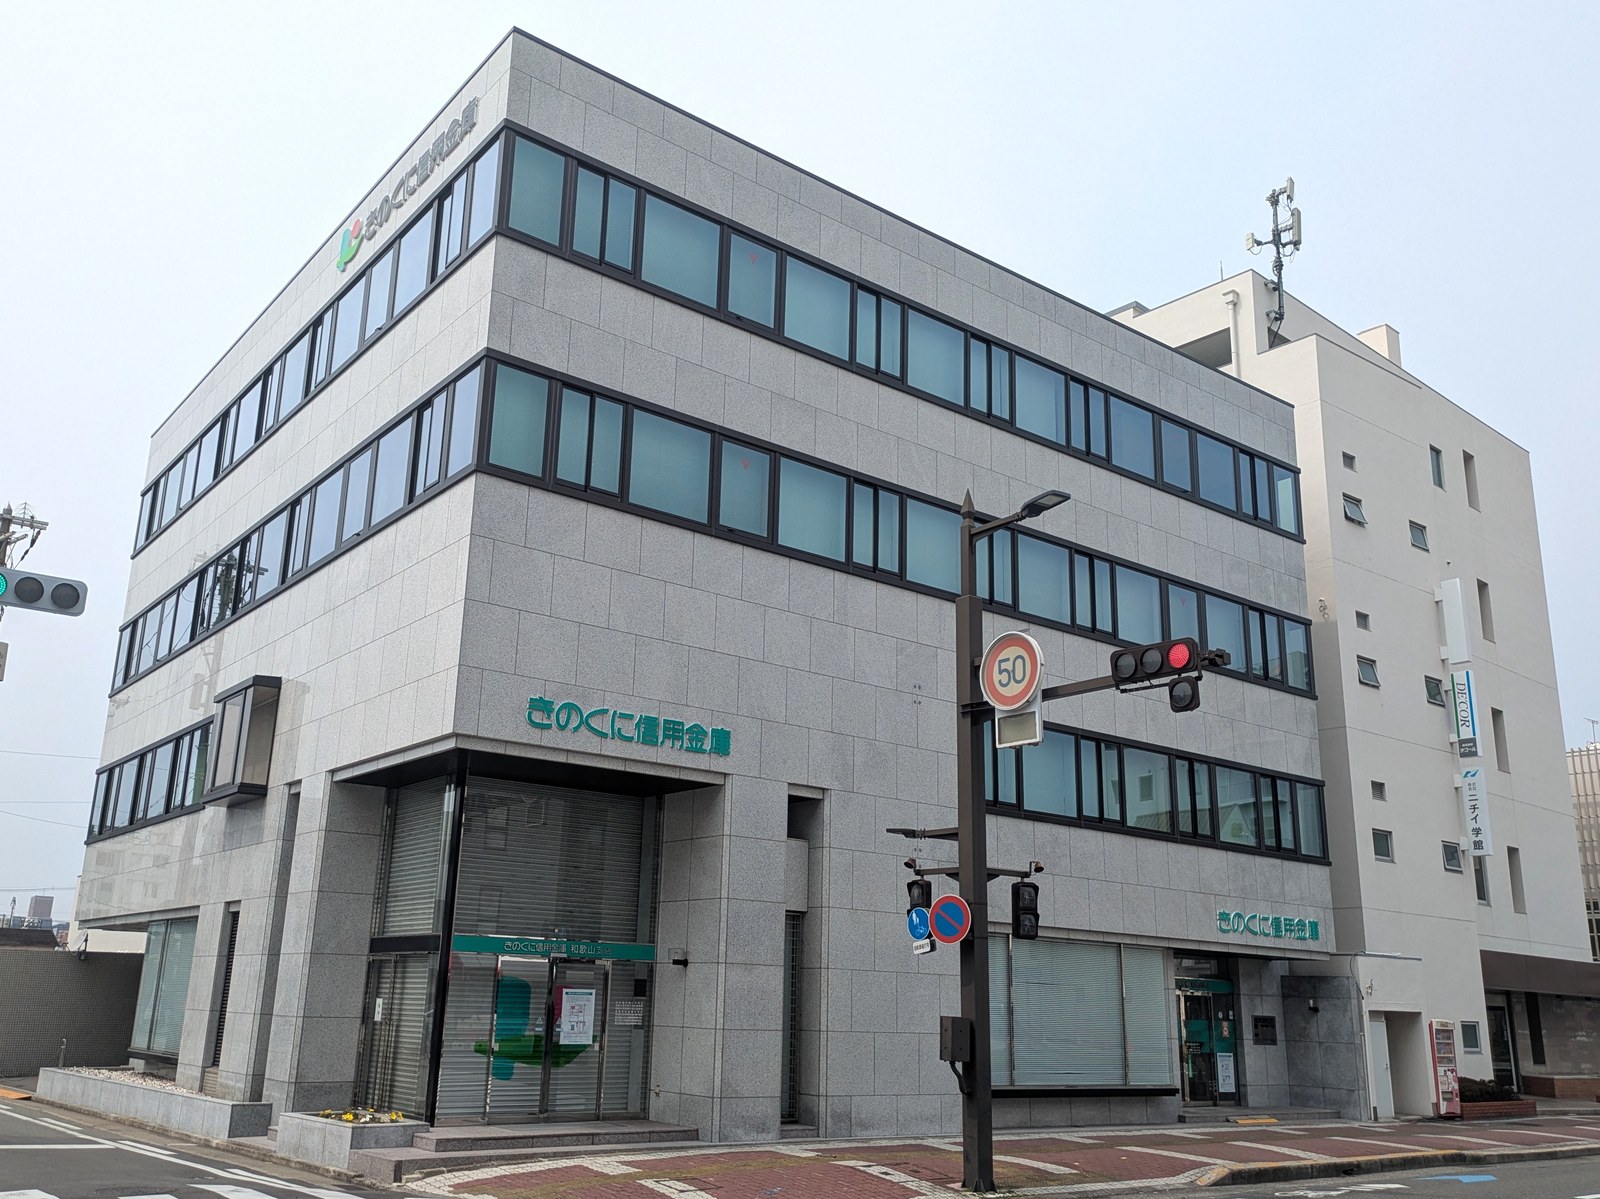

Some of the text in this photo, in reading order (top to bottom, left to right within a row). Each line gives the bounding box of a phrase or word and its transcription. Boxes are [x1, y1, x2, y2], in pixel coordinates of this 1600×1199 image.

[364, 96, 479, 241] きのくに信用金庫
[997, 654, 1027, 688] 50
[525, 695, 732, 757] きのくに信用金庫
[1468, 793, 1484, 850] ニチイ学館
[1216, 909, 1320, 942] きのくに信用金庫
